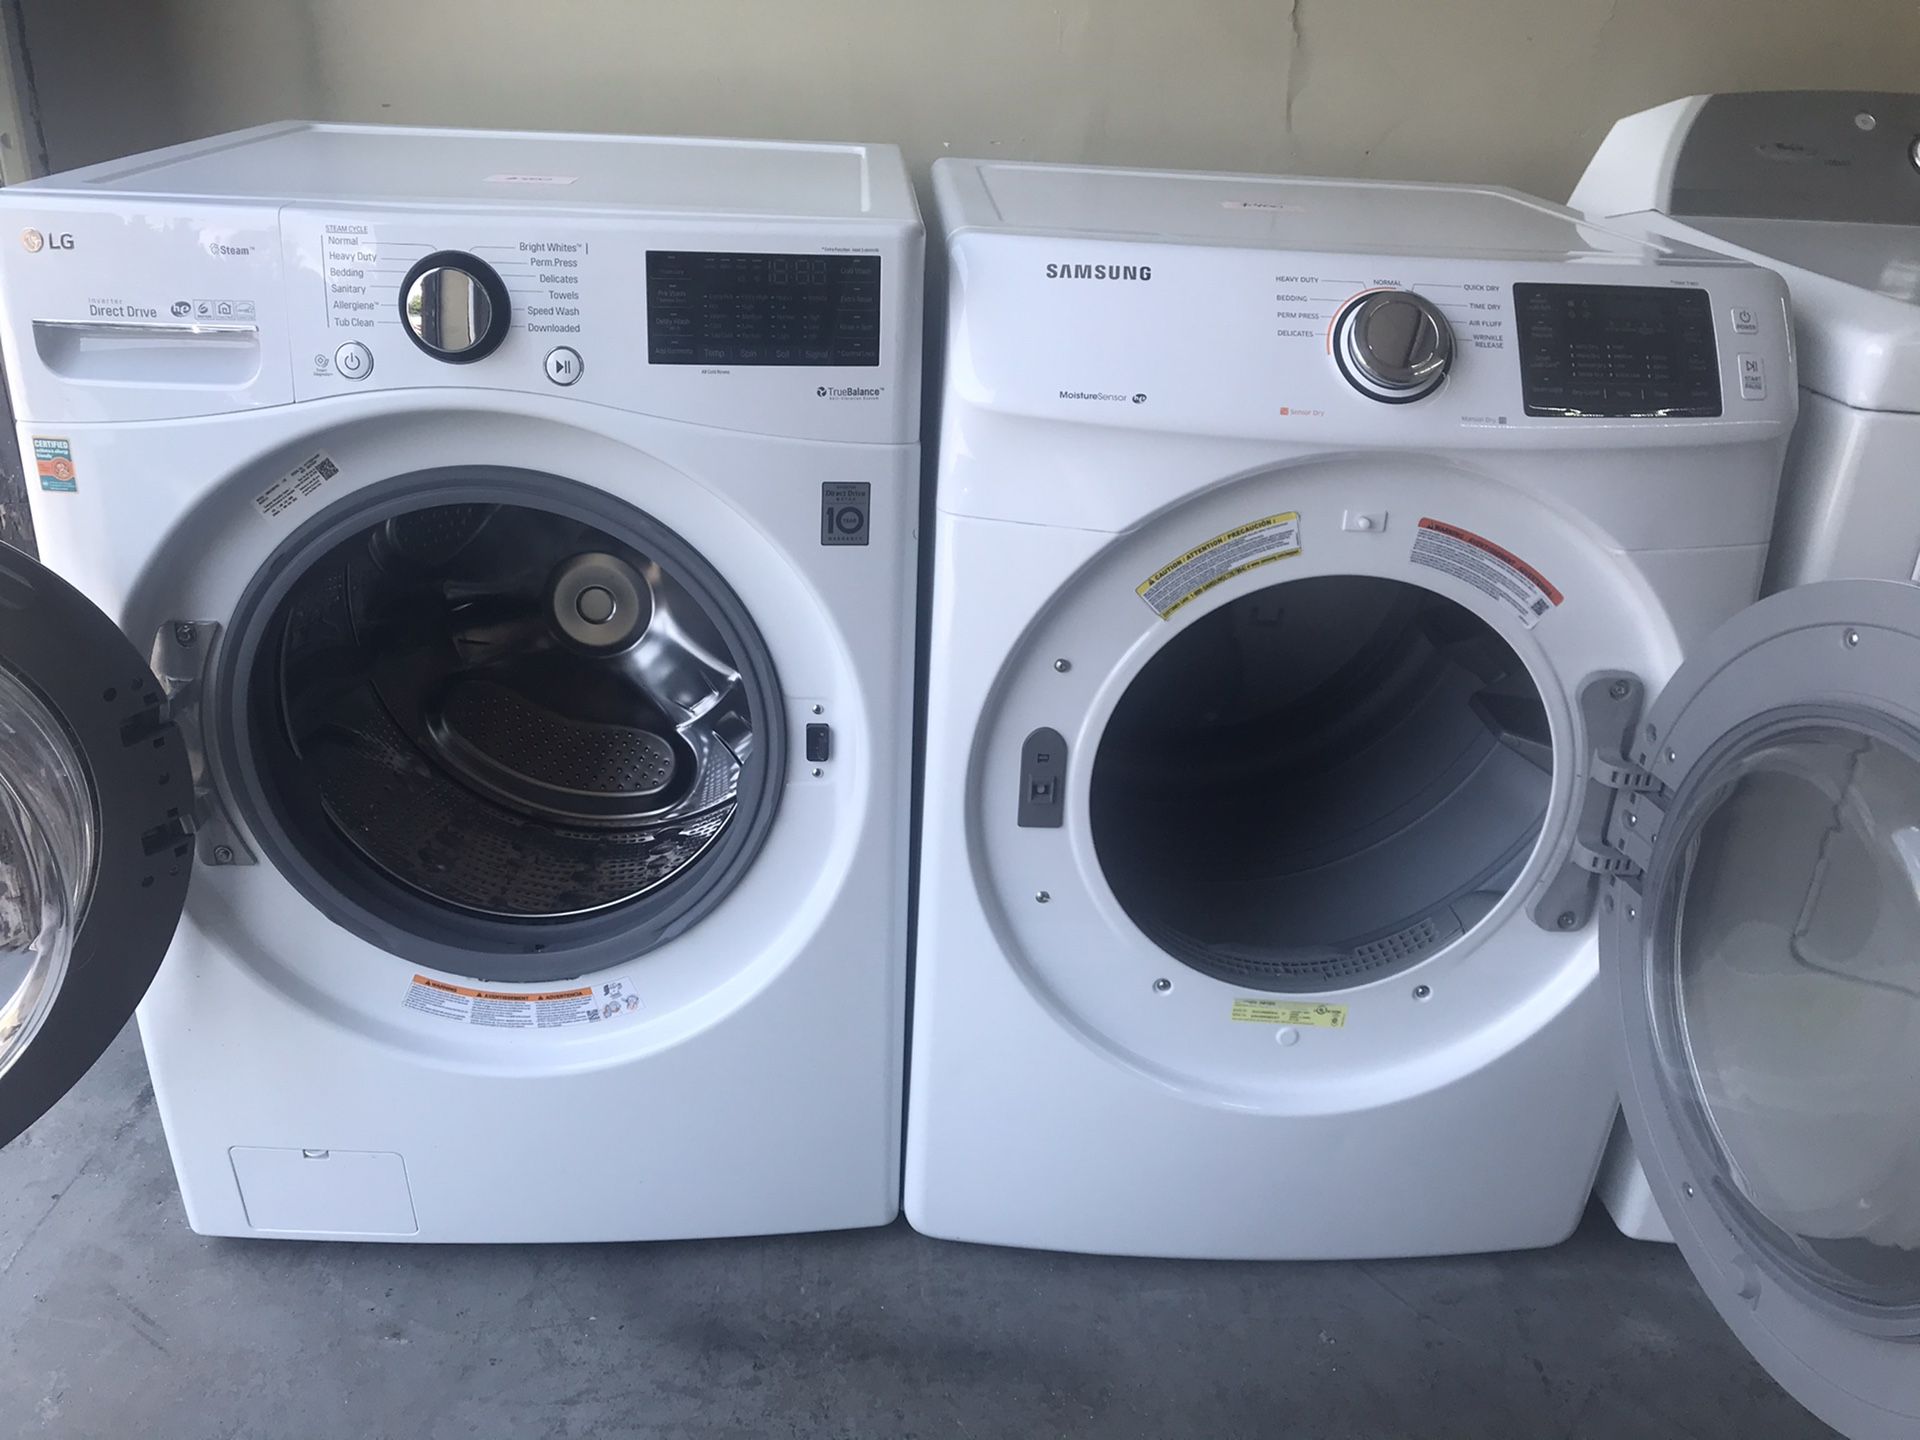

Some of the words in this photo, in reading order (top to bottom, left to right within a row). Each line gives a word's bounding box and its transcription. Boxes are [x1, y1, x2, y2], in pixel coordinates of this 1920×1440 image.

[49, 233, 75, 250] LG
[328, 236, 358, 245] Normal
[520, 242, 545, 253] Bright
[329, 251, 355, 262] Heavy
[357, 252, 377, 262] Duty
[554, 258, 578, 268] Press
[330, 267, 364, 279] Bedding
[1046, 263, 1152, 281] SAMSUNG
[540, 274, 578, 284] Delicates
[331, 284, 366, 295] Sanitary
[549, 290, 579, 300] Towels
[1276, 294, 1308, 302] BEDDING
[89, 304, 125, 317] Direct
[127, 306, 157, 318] Drive
[528, 306, 554, 316] Speed
[555, 307, 580, 316] Wash
[1469, 302, 1486, 310] TIME
[334, 318, 350, 327] Tub
[351, 318, 375, 327] Clean
[528, 323, 581, 333] Downloaded
[826, 506, 865, 534] 10
[1154, 557, 1183, 581] CAUTION
[1186, 538, 1223, 562] ATTENTION
